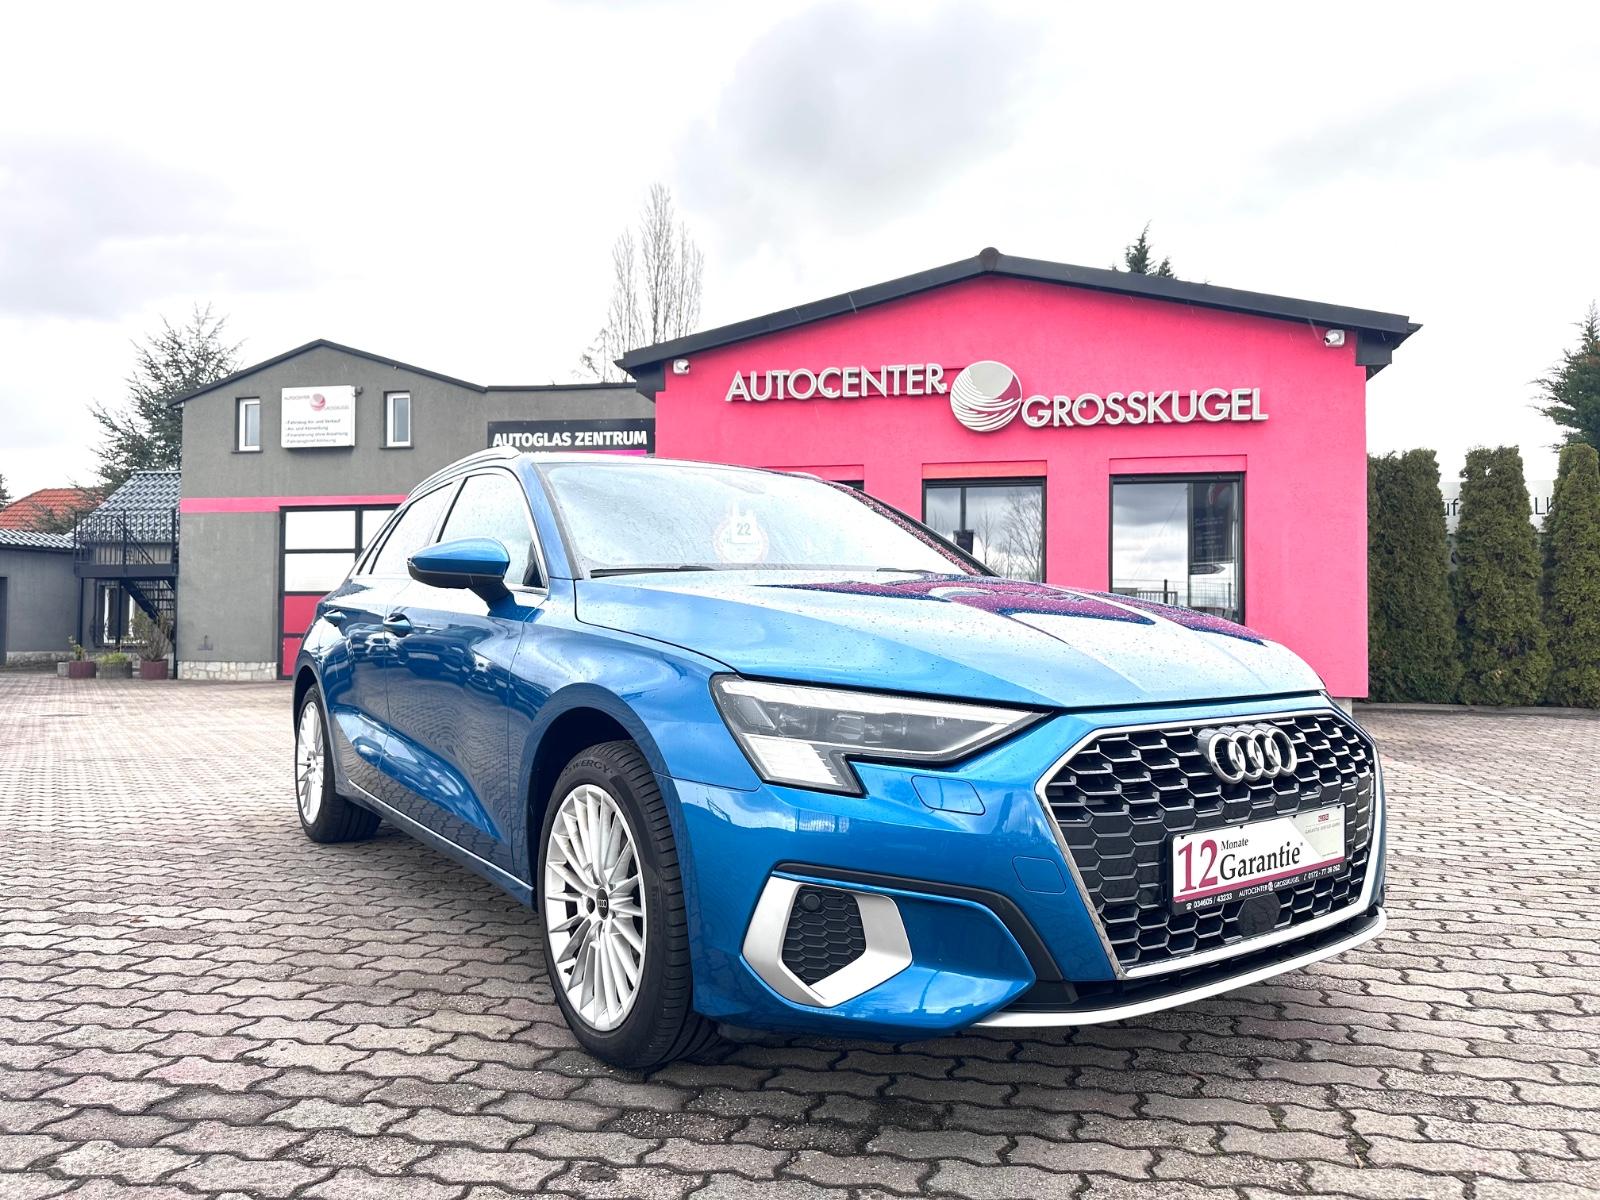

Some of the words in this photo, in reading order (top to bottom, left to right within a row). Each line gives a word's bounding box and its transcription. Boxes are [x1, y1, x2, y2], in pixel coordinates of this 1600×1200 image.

[725, 362, 948, 402] AUTOCENTER
[1020, 387, 1269, 429] GROSSKUGEL
[492, 431, 572, 448] AUTOGLAS
[574, 430, 648, 446] ZENTRUM
[736, 522, 752, 536] 22
[1219, 841, 1301, 881] Garantie
[1221, 837, 1249, 851] Monate
[1178, 839, 1218, 892] 12
